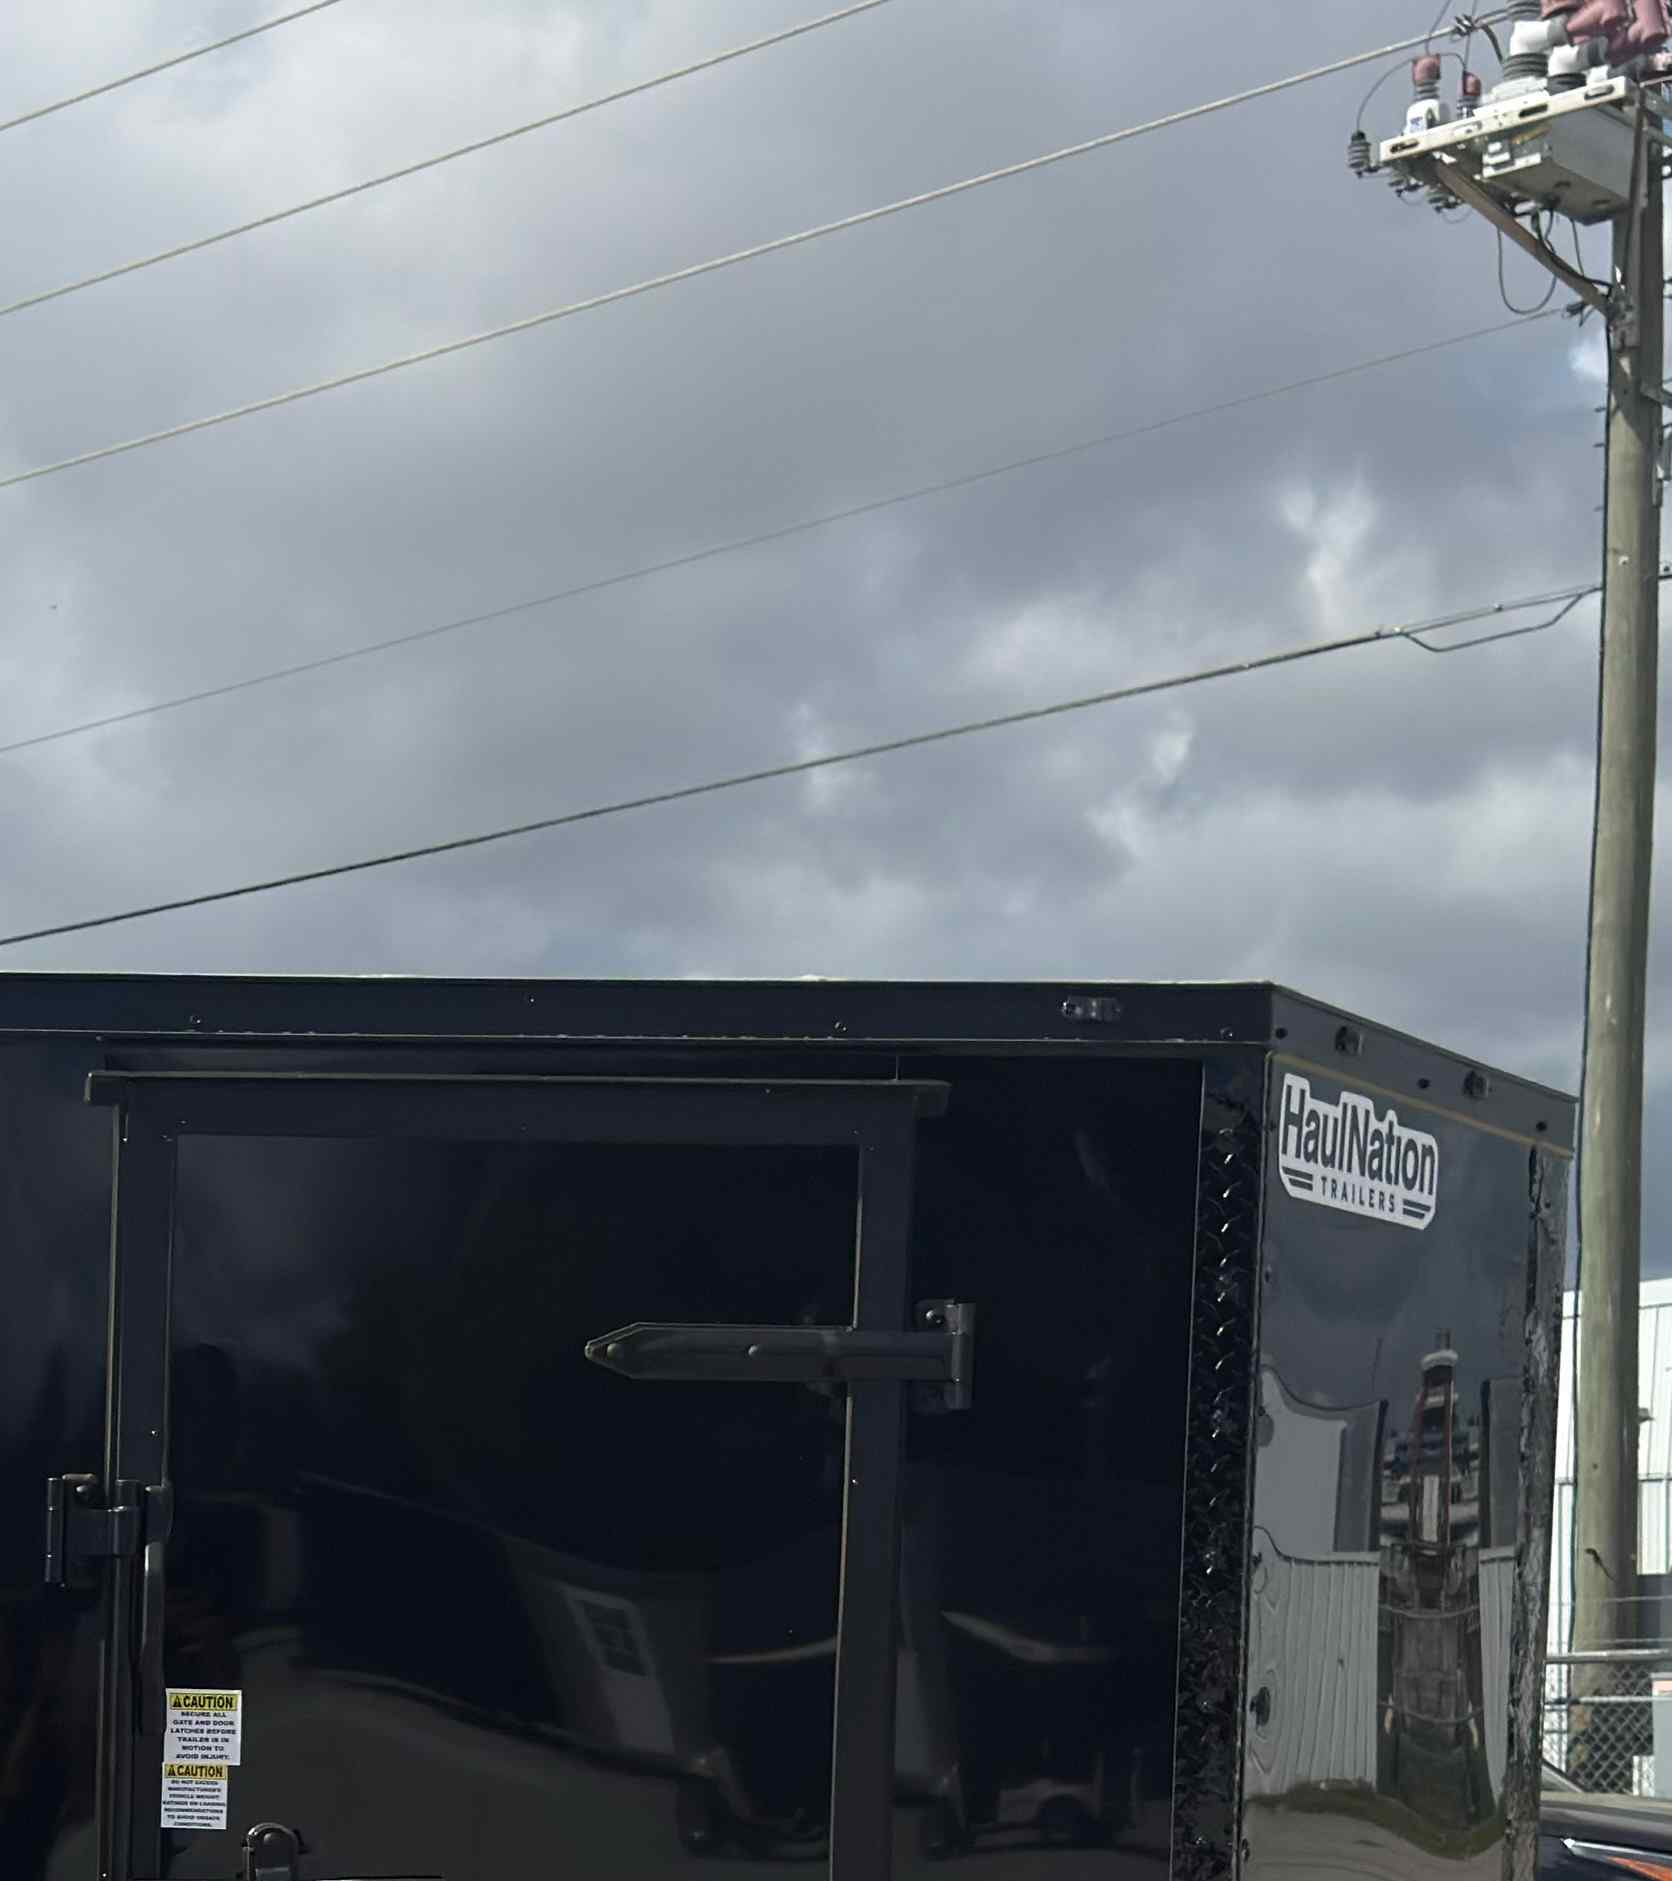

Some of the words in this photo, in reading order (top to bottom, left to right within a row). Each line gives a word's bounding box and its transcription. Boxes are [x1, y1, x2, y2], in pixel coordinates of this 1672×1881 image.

[1281, 1084, 1437, 1196] HaulNation
[1320, 1176, 1396, 1213] TRAILERS
[183, 1695, 233, 1708] CAUTION
[176, 1764, 223, 1777] CAUTION
